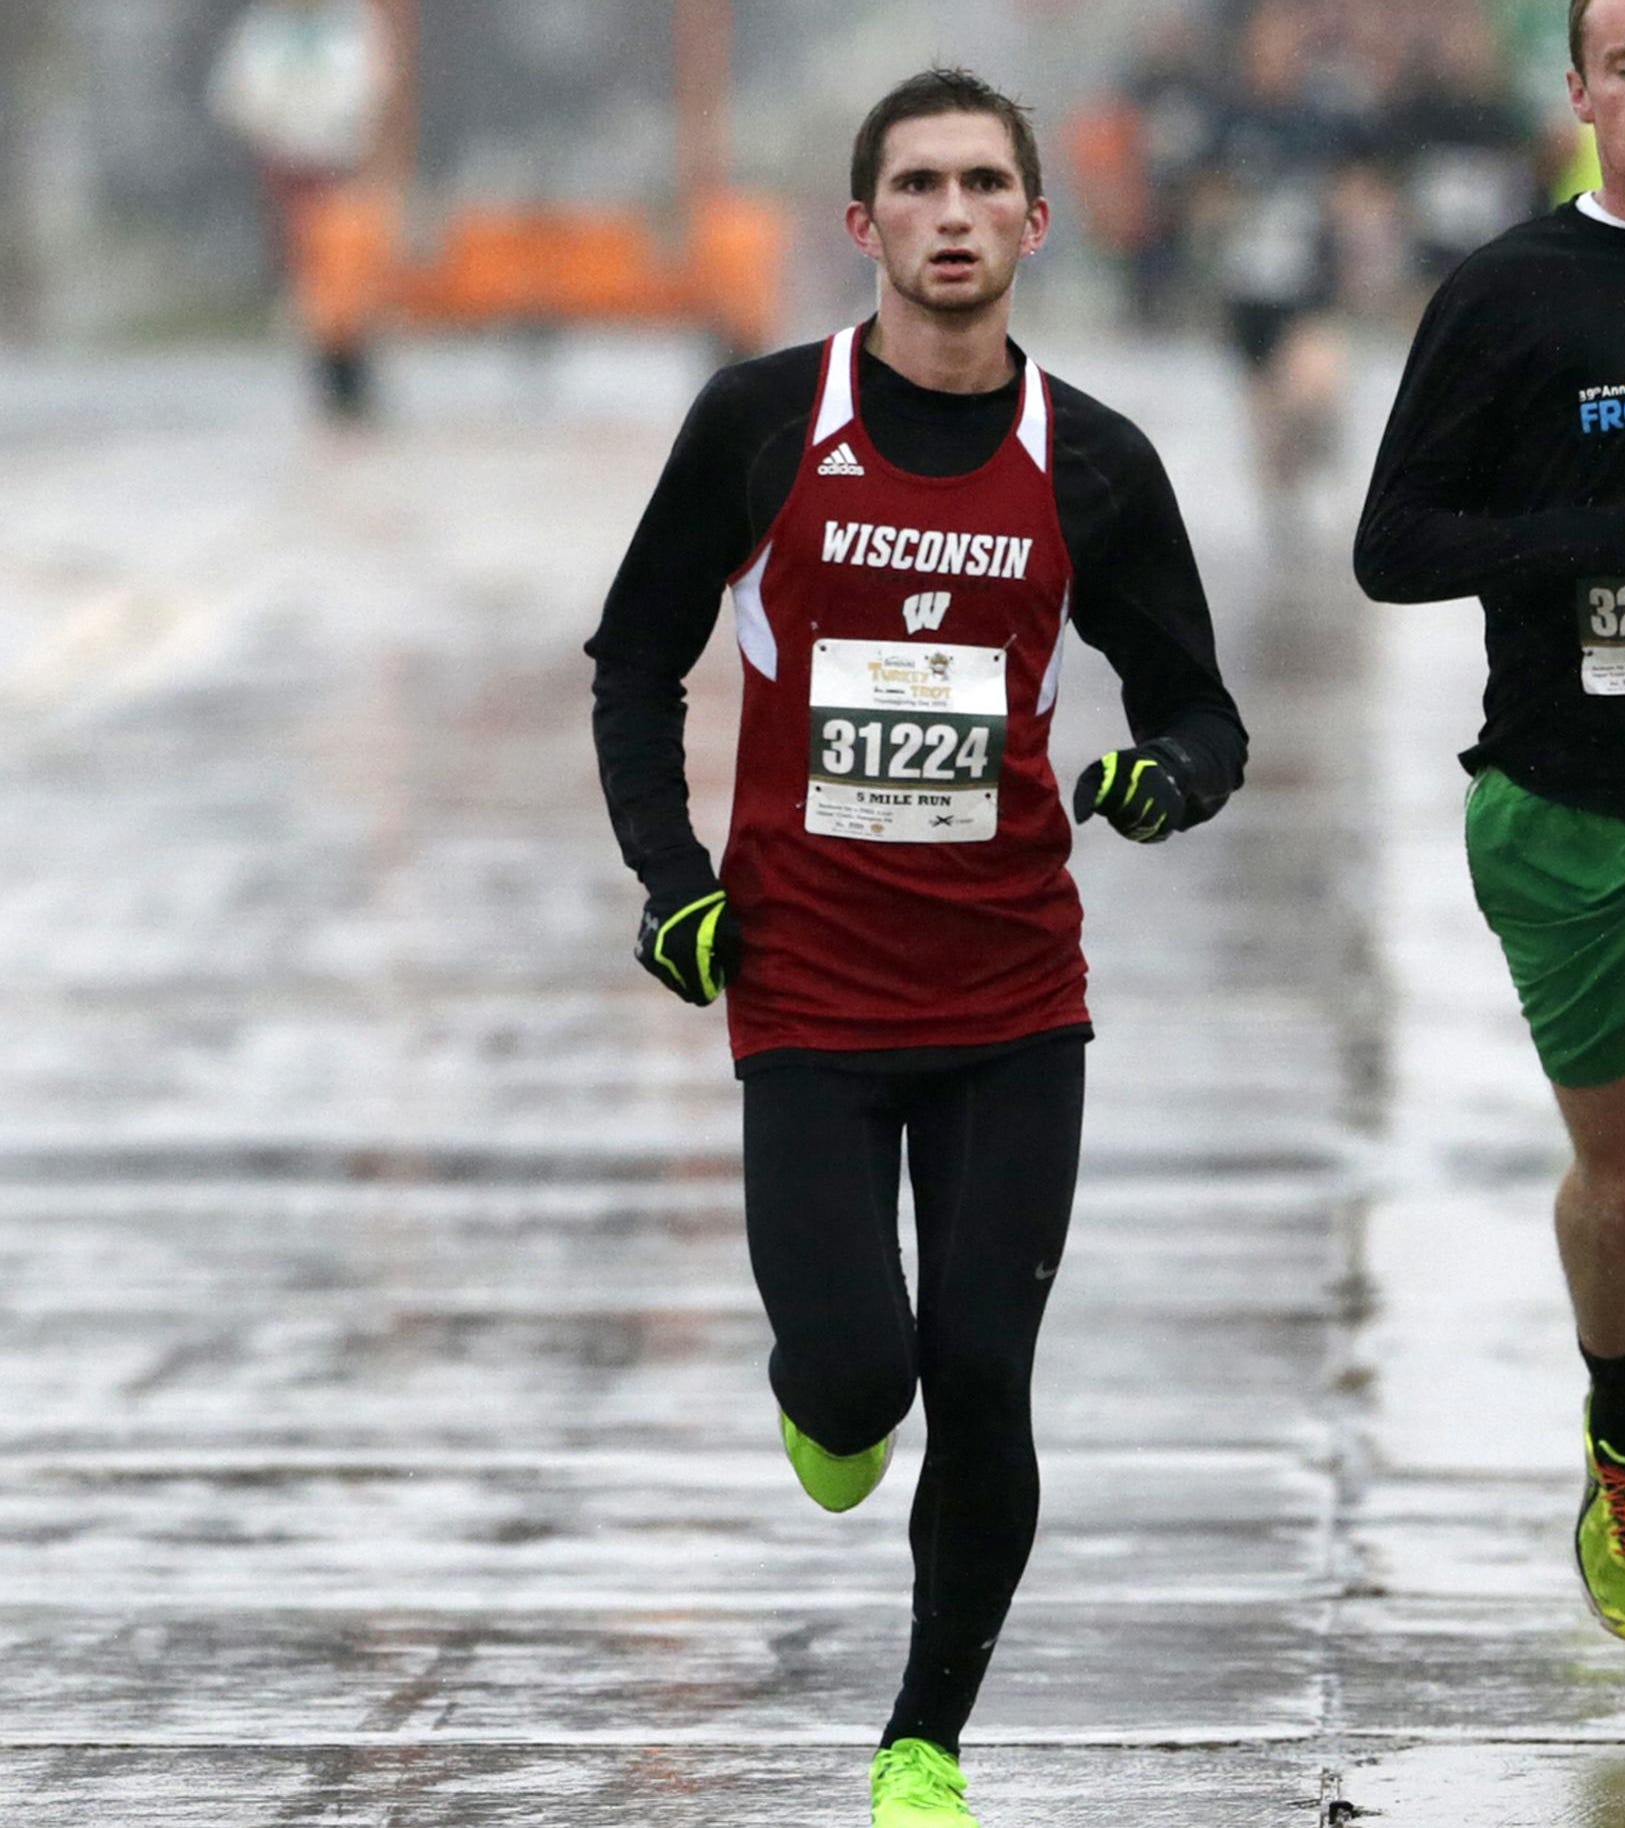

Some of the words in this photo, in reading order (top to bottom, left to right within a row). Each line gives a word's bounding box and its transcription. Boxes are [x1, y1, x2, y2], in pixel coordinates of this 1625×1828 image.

[817, 462, 865, 476] adidas
[821, 520, 1033, 580] WISCONSIN
[902, 591, 952, 635] W
[821, 719, 990, 780] 31224
[856, 792, 865, 802] 5
[869, 793, 912, 805] MILE
[918, 794, 952, 807] RUN
